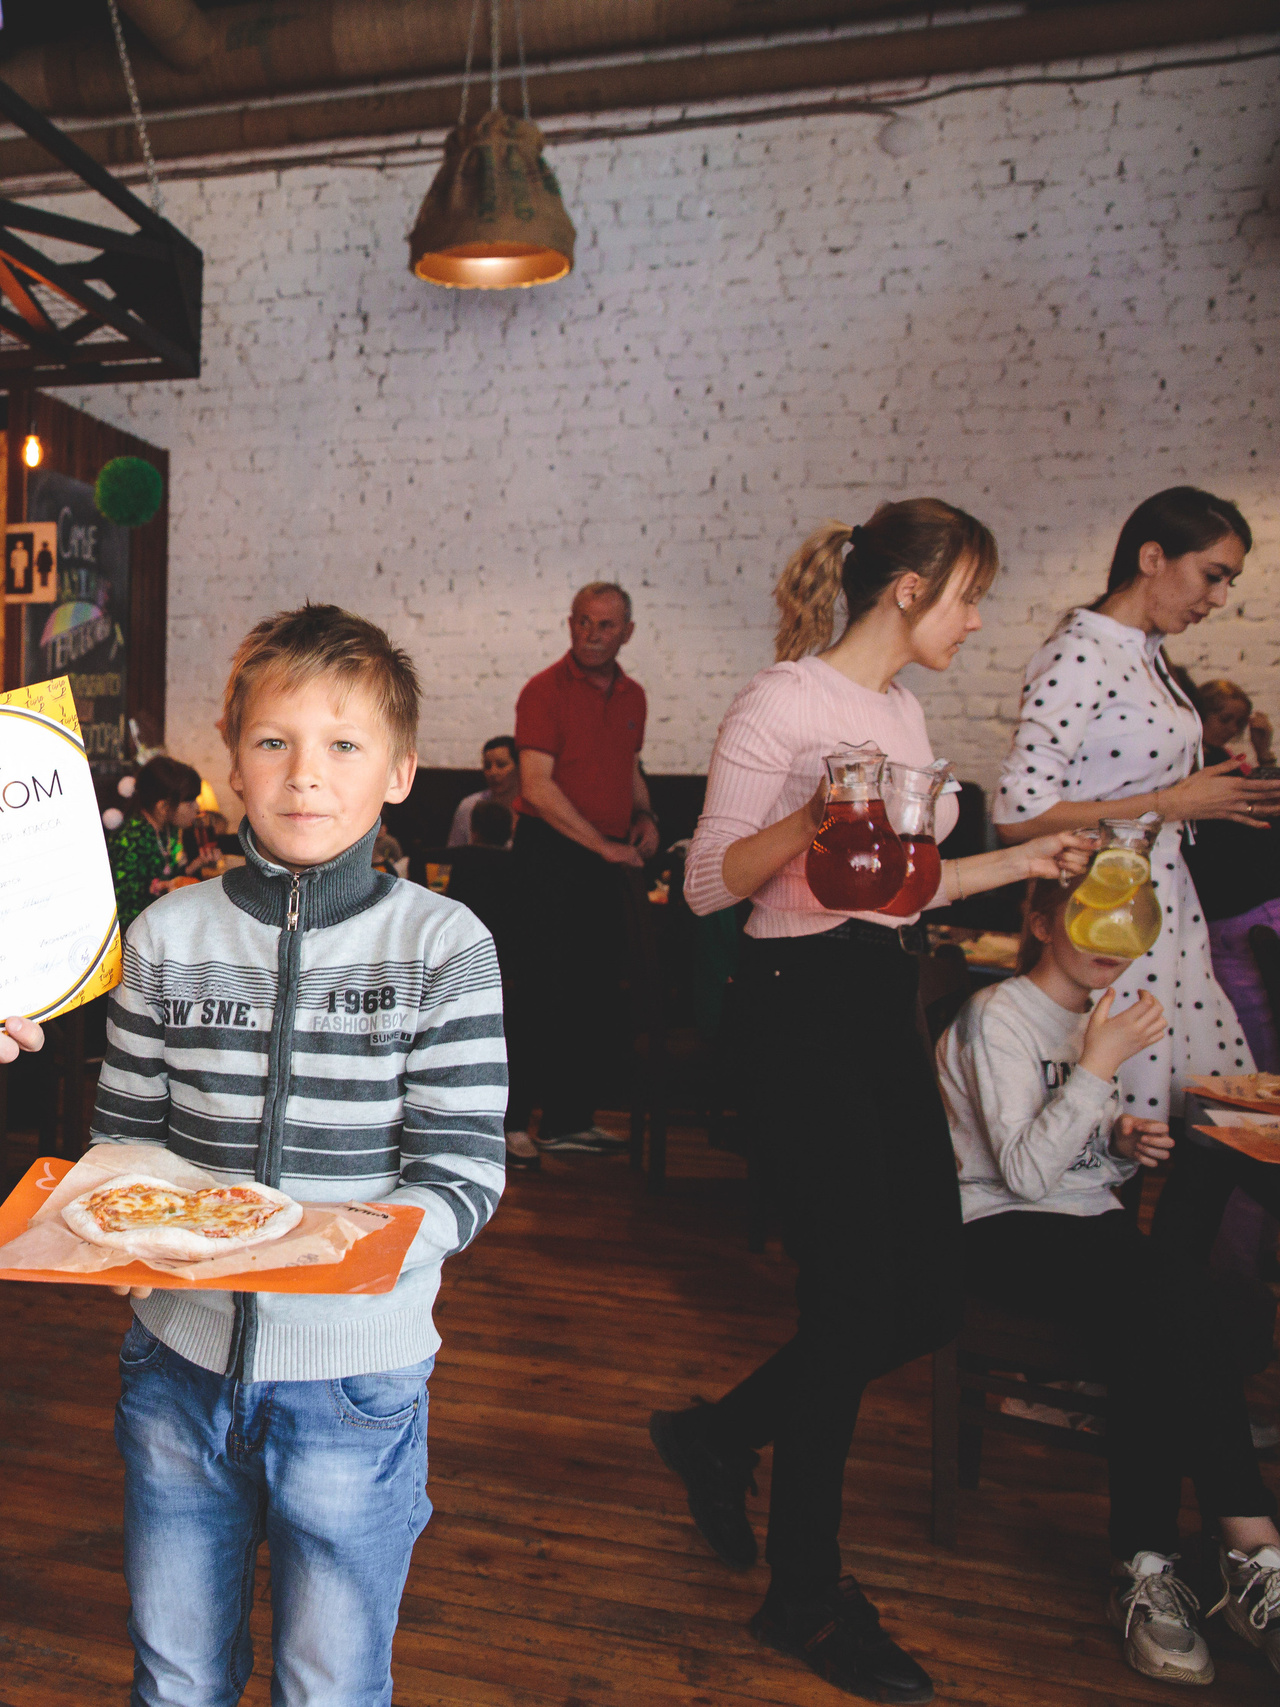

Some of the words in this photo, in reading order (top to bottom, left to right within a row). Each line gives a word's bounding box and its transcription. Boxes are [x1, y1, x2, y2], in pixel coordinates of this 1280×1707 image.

[201, 999, 256, 1028] SNE.
[327, 985, 397, 1014] 1968
[313, 1015, 378, 1033] FASHION
[381, 1013, 409, 1030] BOY
